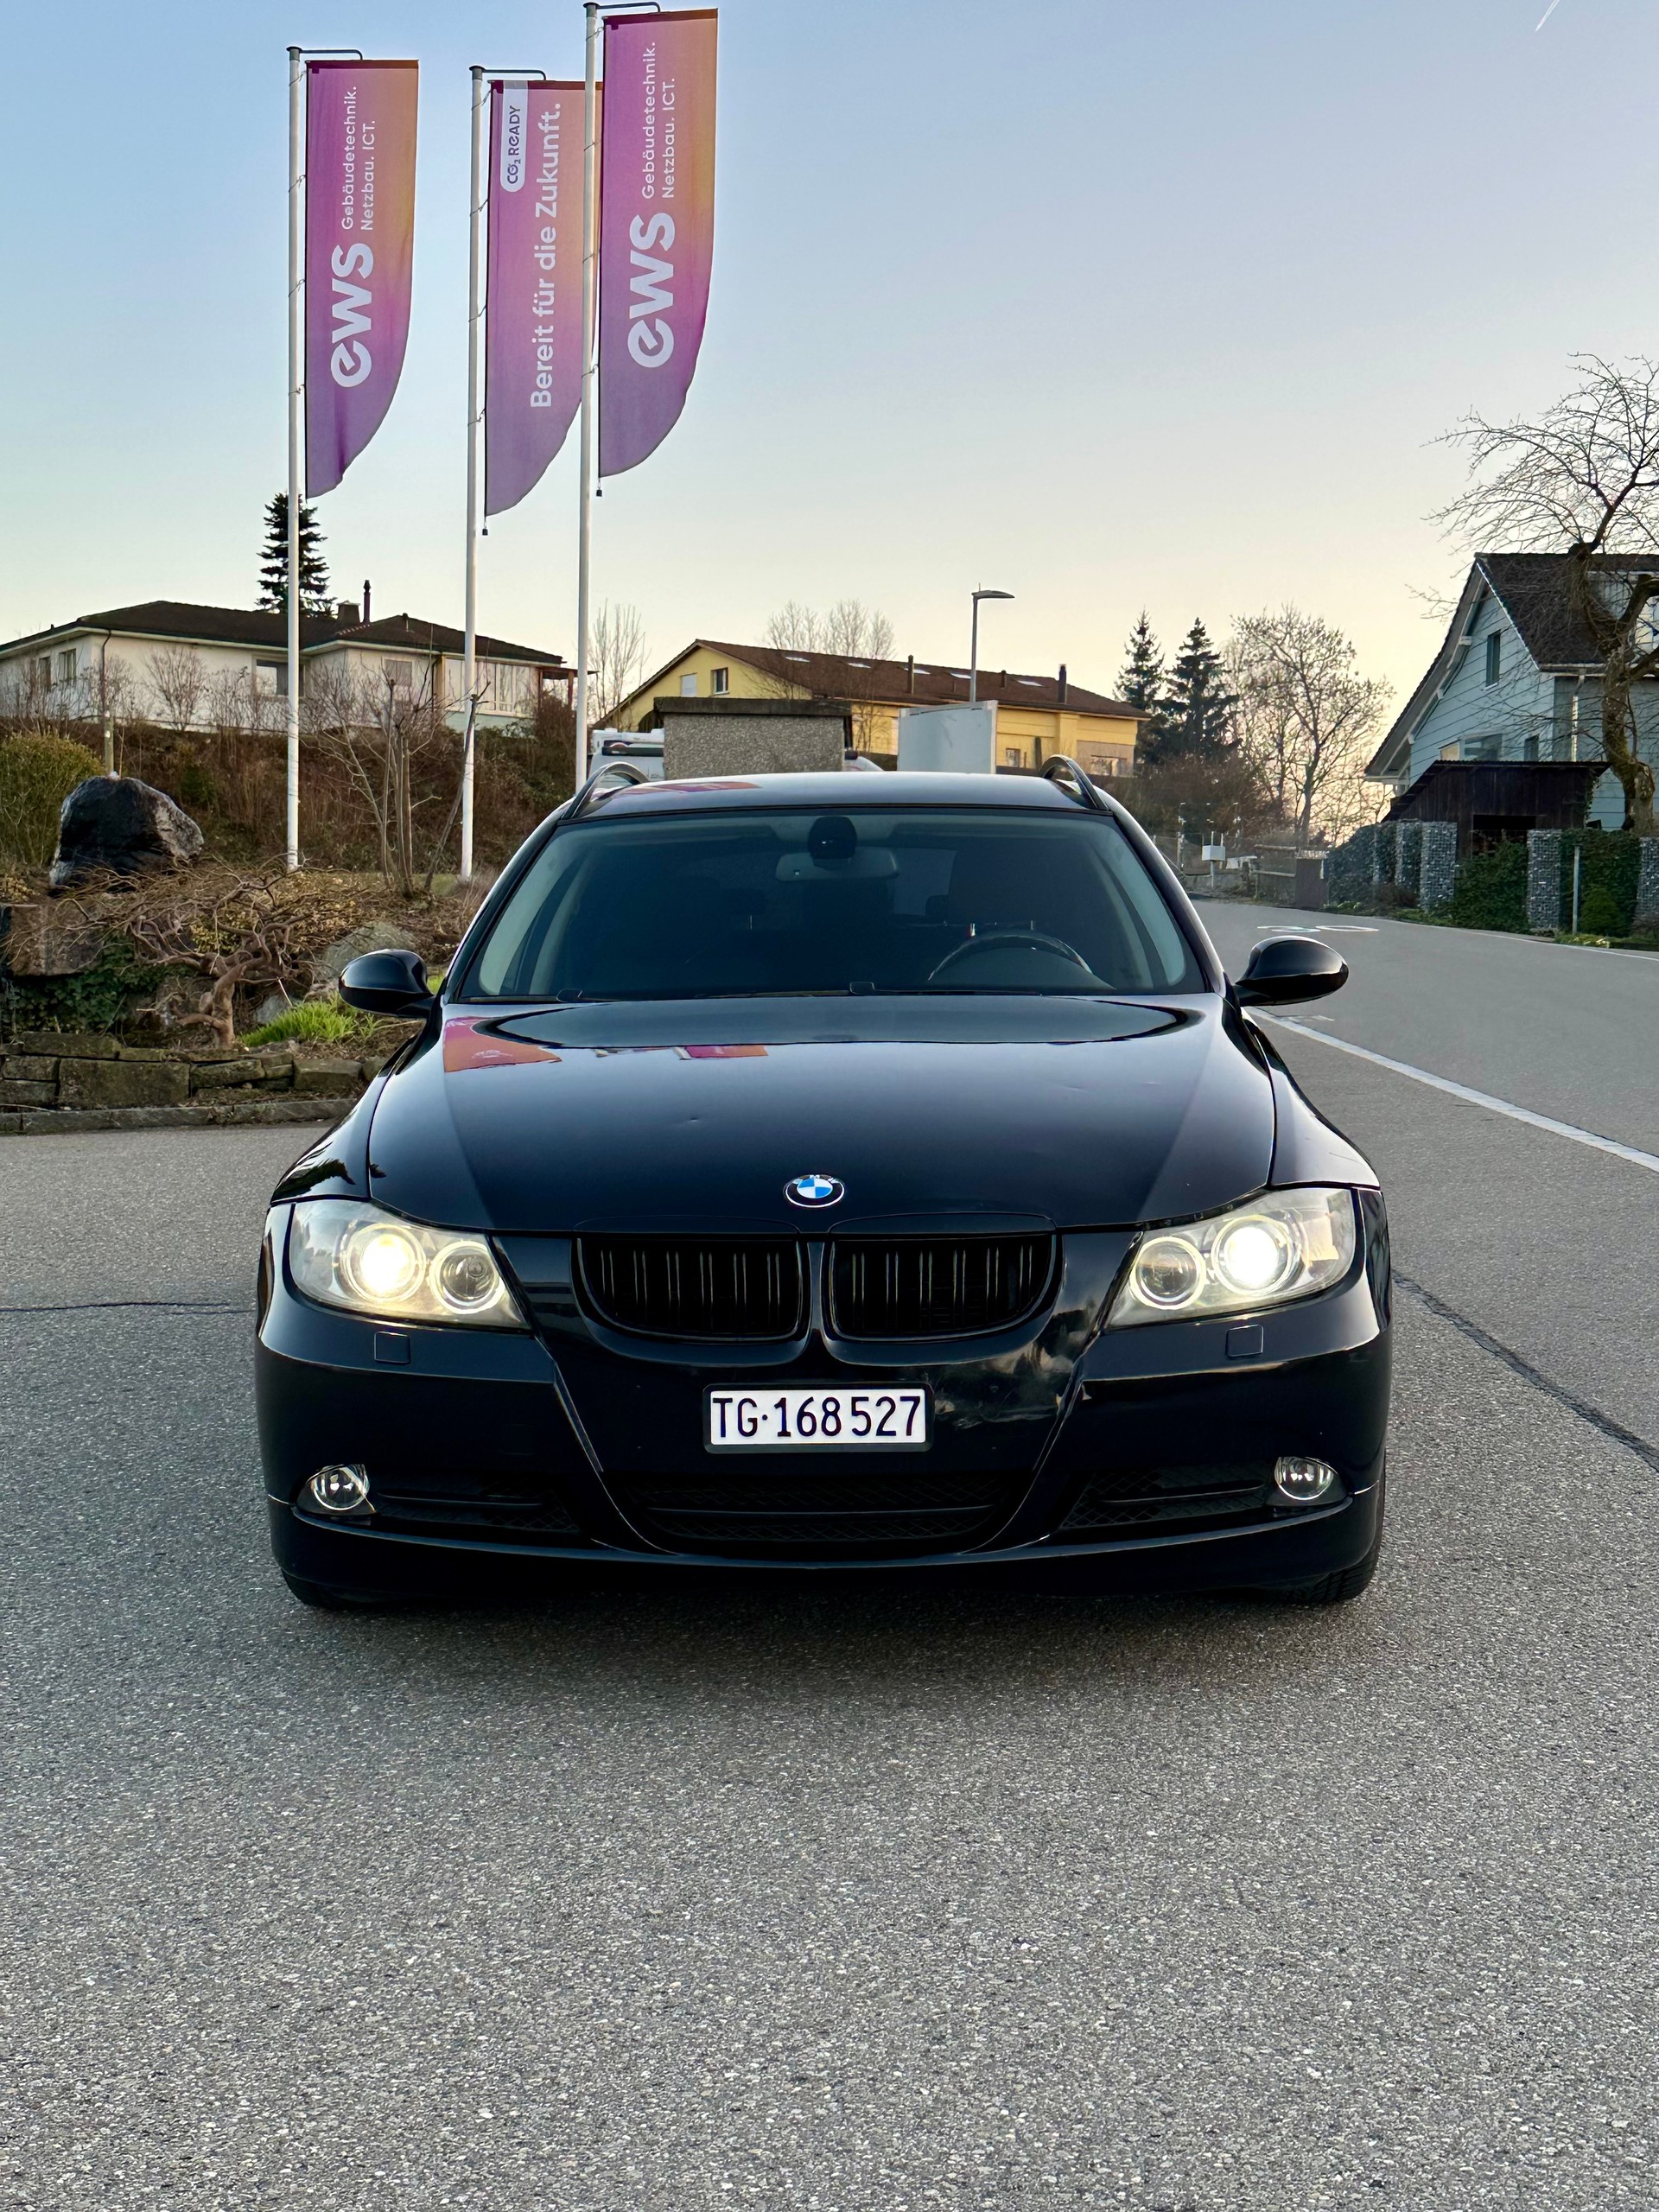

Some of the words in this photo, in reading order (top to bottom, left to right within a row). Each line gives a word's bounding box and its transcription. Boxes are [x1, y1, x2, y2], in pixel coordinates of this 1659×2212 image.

[642, 42, 656, 199] Gebäudetechnik.
[662, 78, 676, 111] ICT.
[341, 86, 357, 230] Gebäudetechnik.
[362, 120, 376, 150] ICT.
[536, 104, 561, 218] Zukunft.
[662, 117, 675, 199] Netzbau.
[361, 156, 375, 231] Netzbau.
[534, 226, 556, 270] die
[532, 278, 555, 317] für
[530, 325, 555, 408] Bereit
